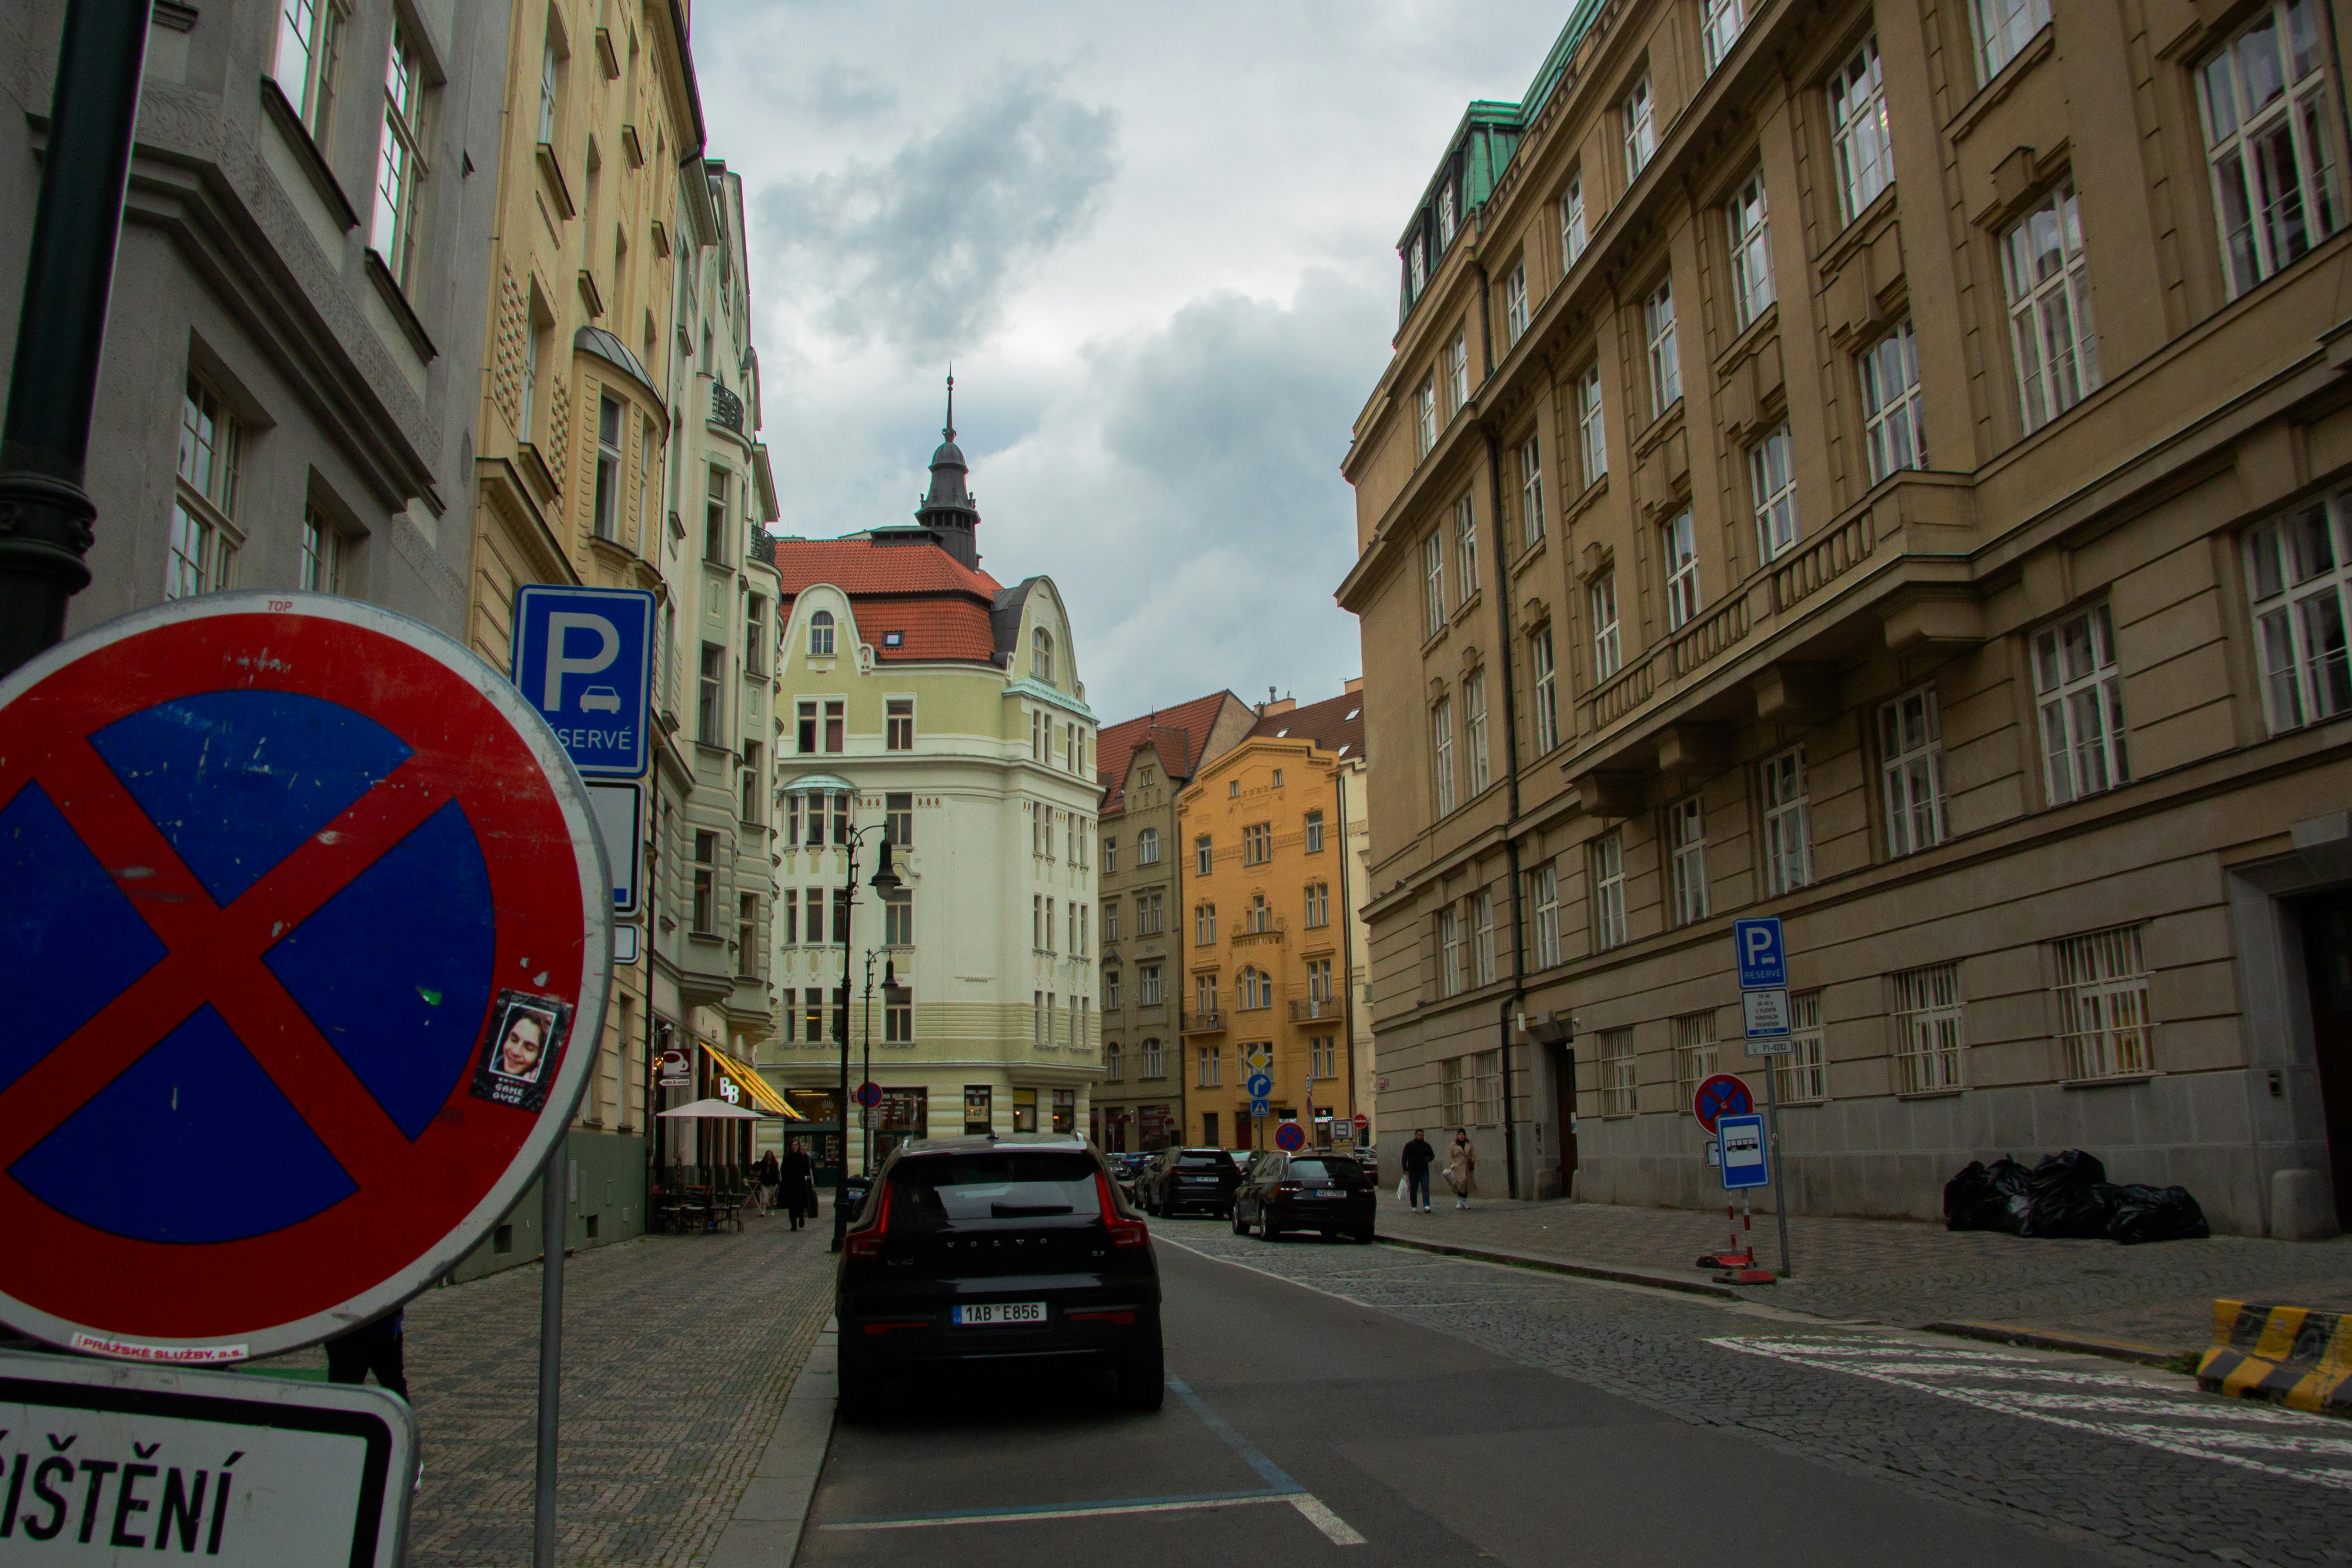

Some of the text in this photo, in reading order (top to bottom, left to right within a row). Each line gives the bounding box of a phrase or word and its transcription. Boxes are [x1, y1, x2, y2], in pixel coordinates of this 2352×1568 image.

[268, 600, 293, 612] TOP
[543, 611, 620, 711] P
[548, 723, 632, 750] SERVÉ
[1746, 927, 1772, 965] P
[1744, 967, 1782, 979] RÉSERVÉ
[493, 1091, 521, 1105] OVER
[495, 1082, 524, 1096] GAME
[946, 1237, 1047, 1249] VOLVO
[966, 1304, 1039, 1322] 1AB E856
[82, 1338, 244, 1360] PRAŽSKÉ SLUŽBY, a.s.
[0, 1430, 246, 1555] IŠTĚNÍ
